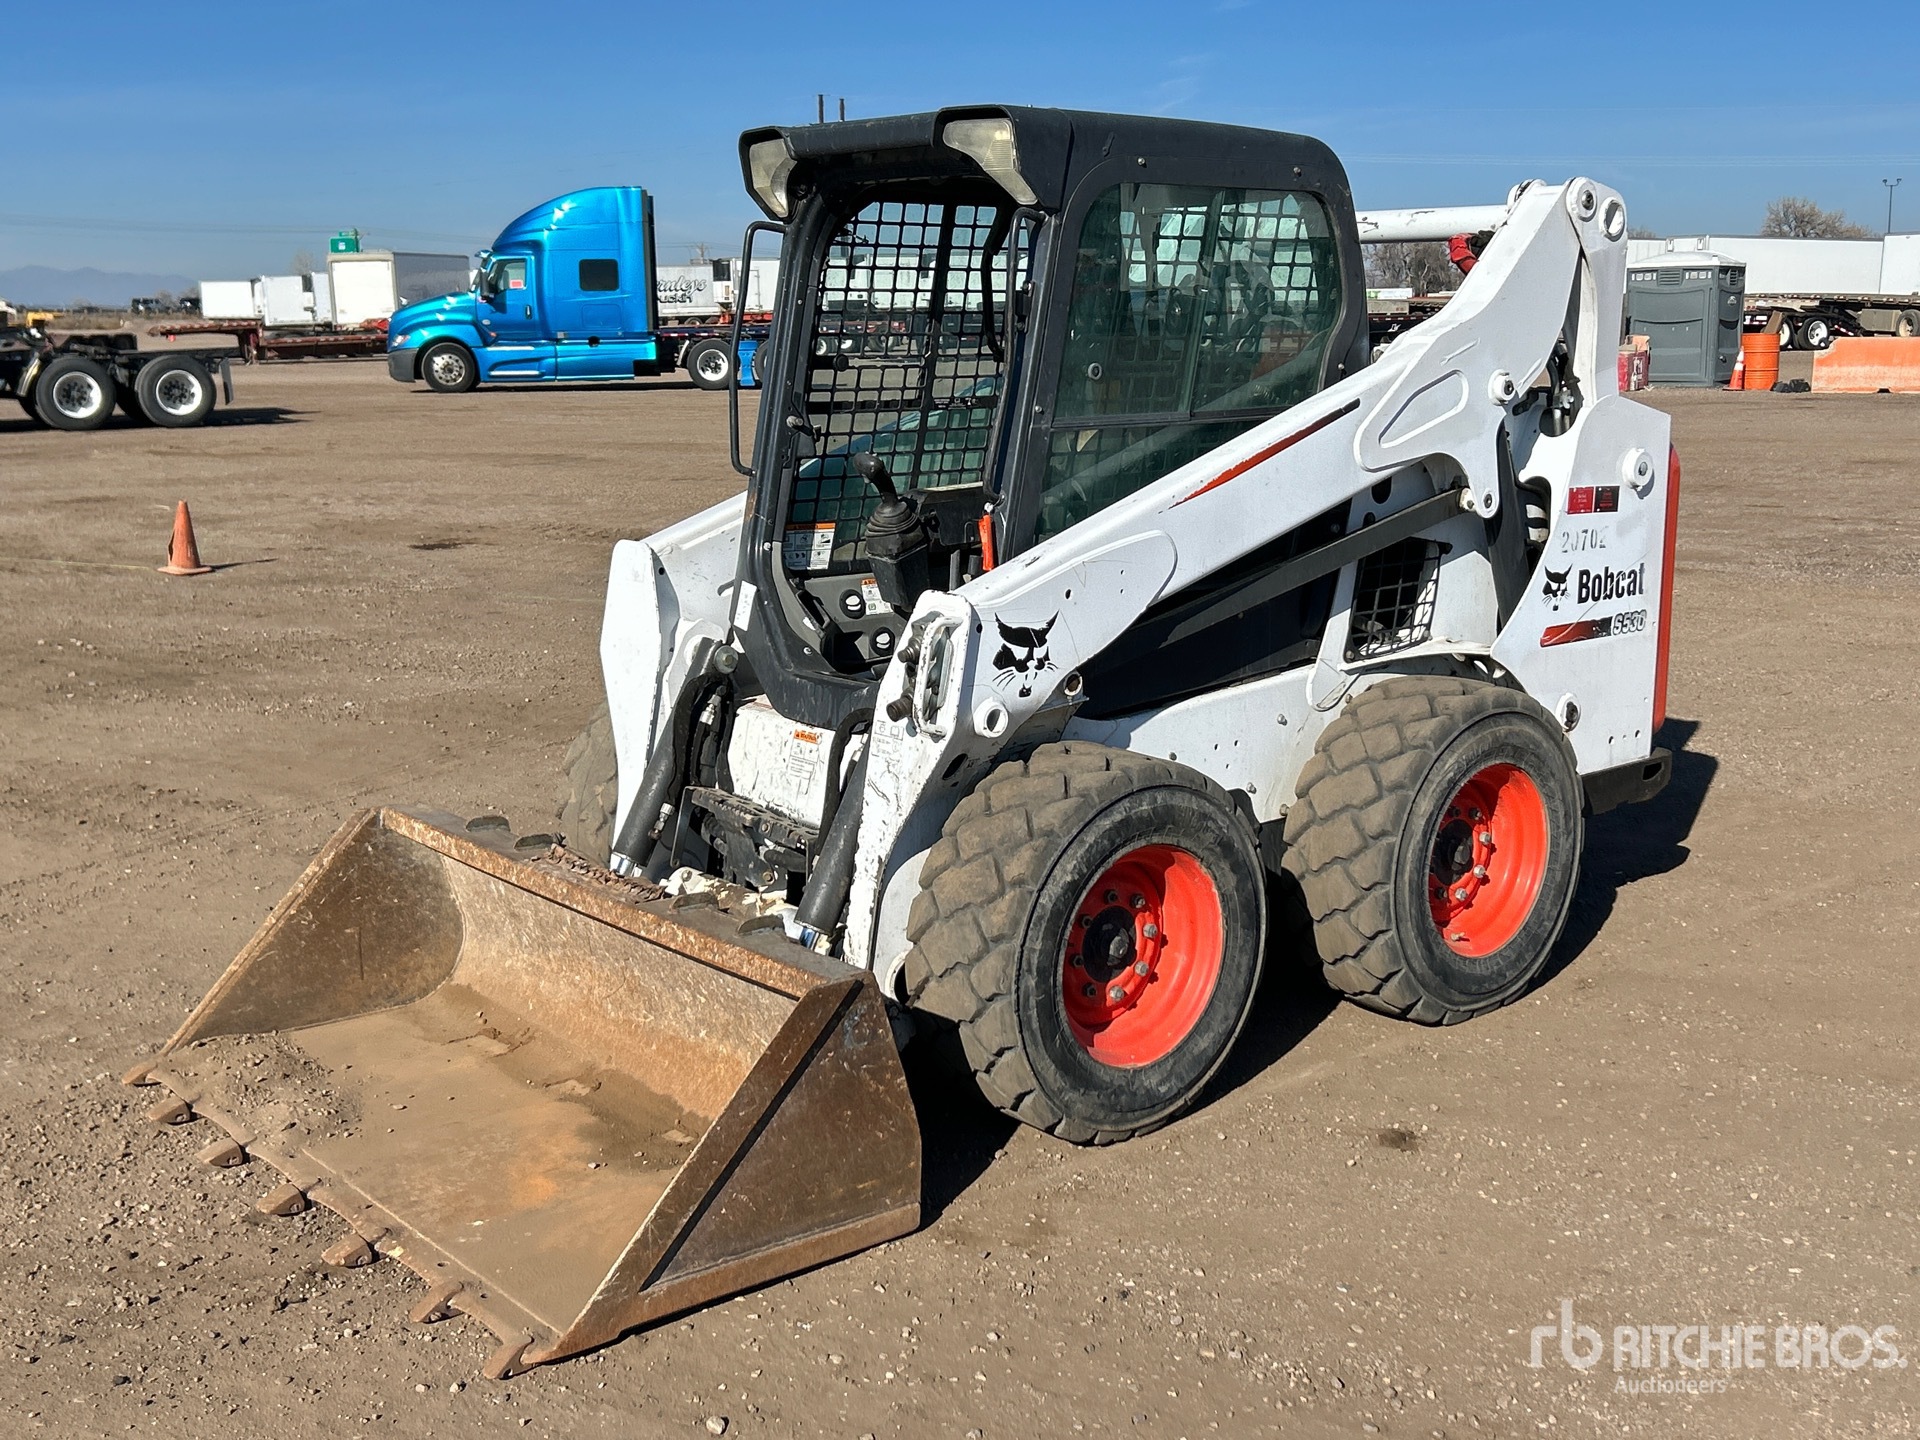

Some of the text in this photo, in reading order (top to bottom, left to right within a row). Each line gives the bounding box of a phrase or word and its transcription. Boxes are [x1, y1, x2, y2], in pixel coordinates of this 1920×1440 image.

[657, 275, 707, 297] rnleys
[1577, 563, 1645, 605] Bobcat
[1613, 609, 1647, 636] S530
